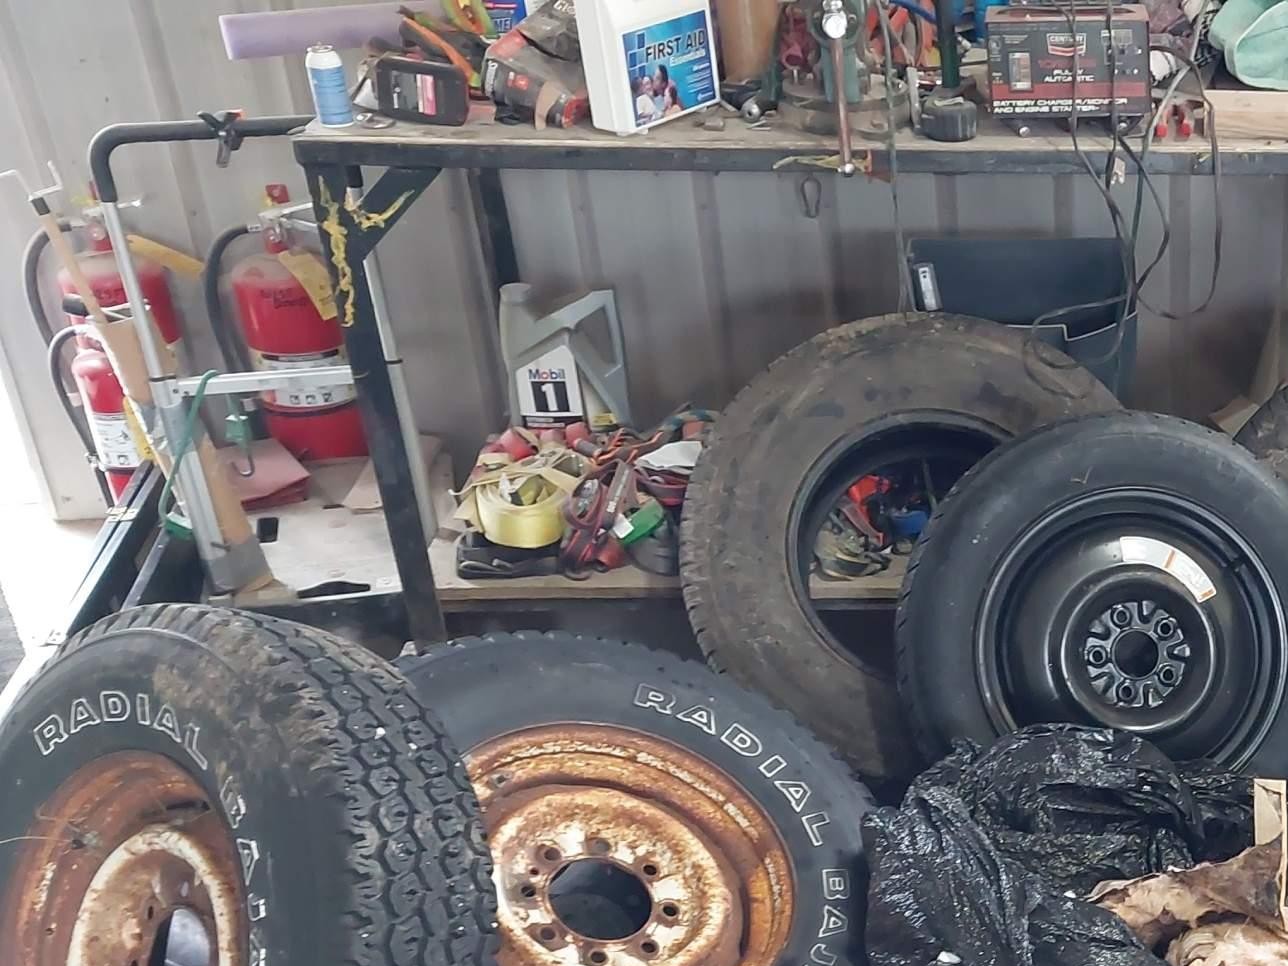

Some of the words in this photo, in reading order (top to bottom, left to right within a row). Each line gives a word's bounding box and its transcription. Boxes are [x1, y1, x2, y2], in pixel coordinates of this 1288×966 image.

[645, 36, 682, 62] FIRST
[685, 29, 706, 50] AID
[993, 100, 1035, 108] BATTERY
[528, 368, 566, 380] Mobil
[541, 382, 559, 412] 1
[33, 690, 208, 771] RADIAL
[633, 683, 830, 847] RADIAL
